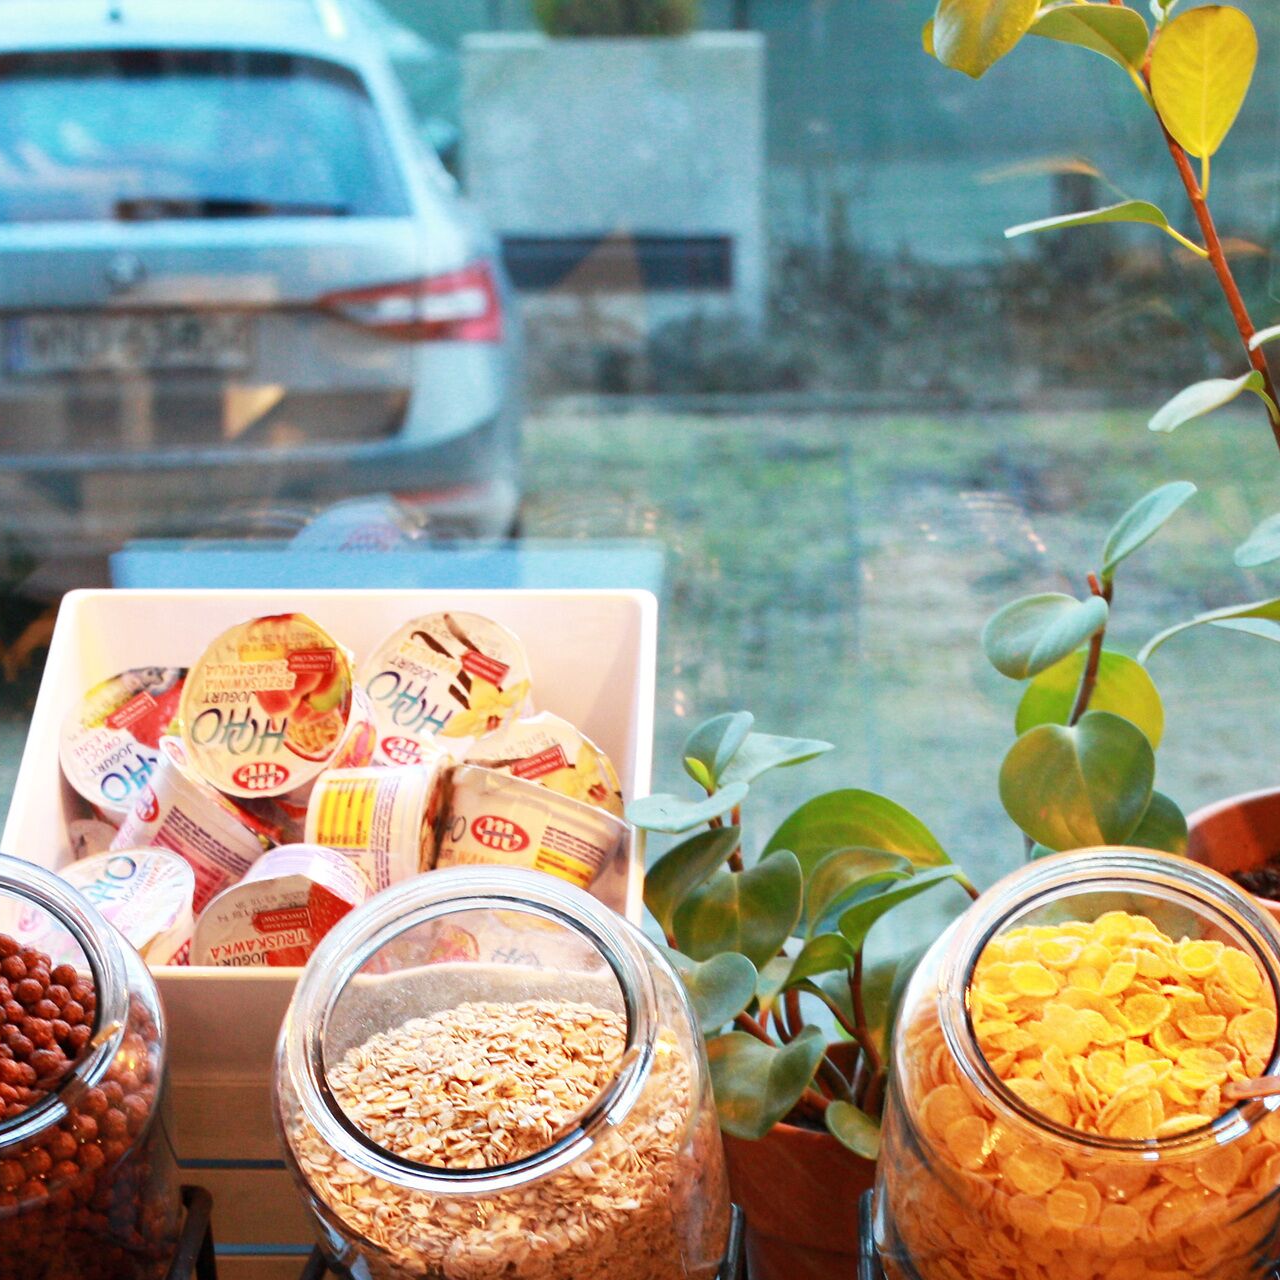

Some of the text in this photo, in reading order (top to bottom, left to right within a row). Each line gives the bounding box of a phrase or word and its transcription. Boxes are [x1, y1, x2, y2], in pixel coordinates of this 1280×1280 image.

[388, 657, 438, 681] JOGURT
[201, 690, 256, 705] JOGURT
[90, 742, 134, 777] JOGURT
[210, 931, 309, 958] TRUSKAWKA
